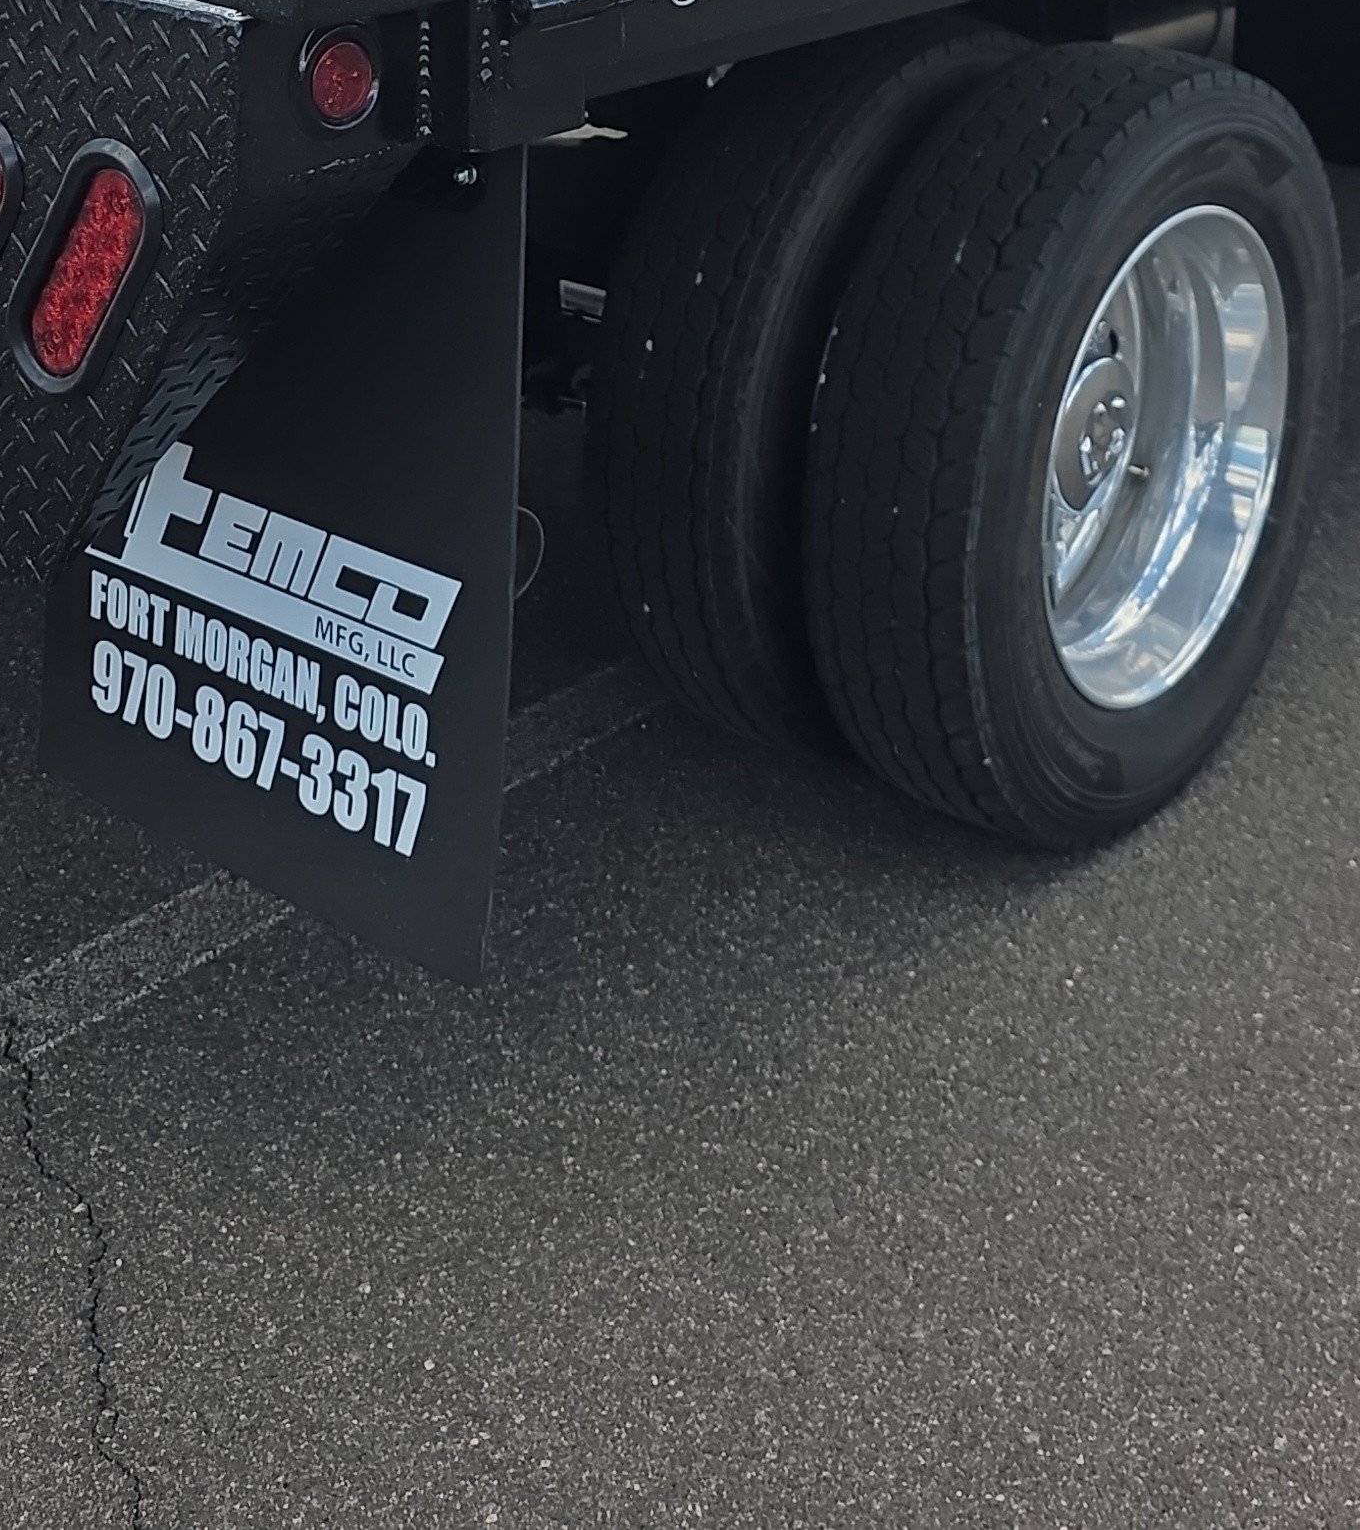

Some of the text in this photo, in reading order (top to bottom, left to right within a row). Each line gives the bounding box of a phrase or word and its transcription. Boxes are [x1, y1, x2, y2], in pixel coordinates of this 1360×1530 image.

[89, 569, 437, 769] FORT MORGAN, COLO.
[313, 615, 419, 680] MFG, LLC
[90, 639, 428, 858] 970-867-3317
